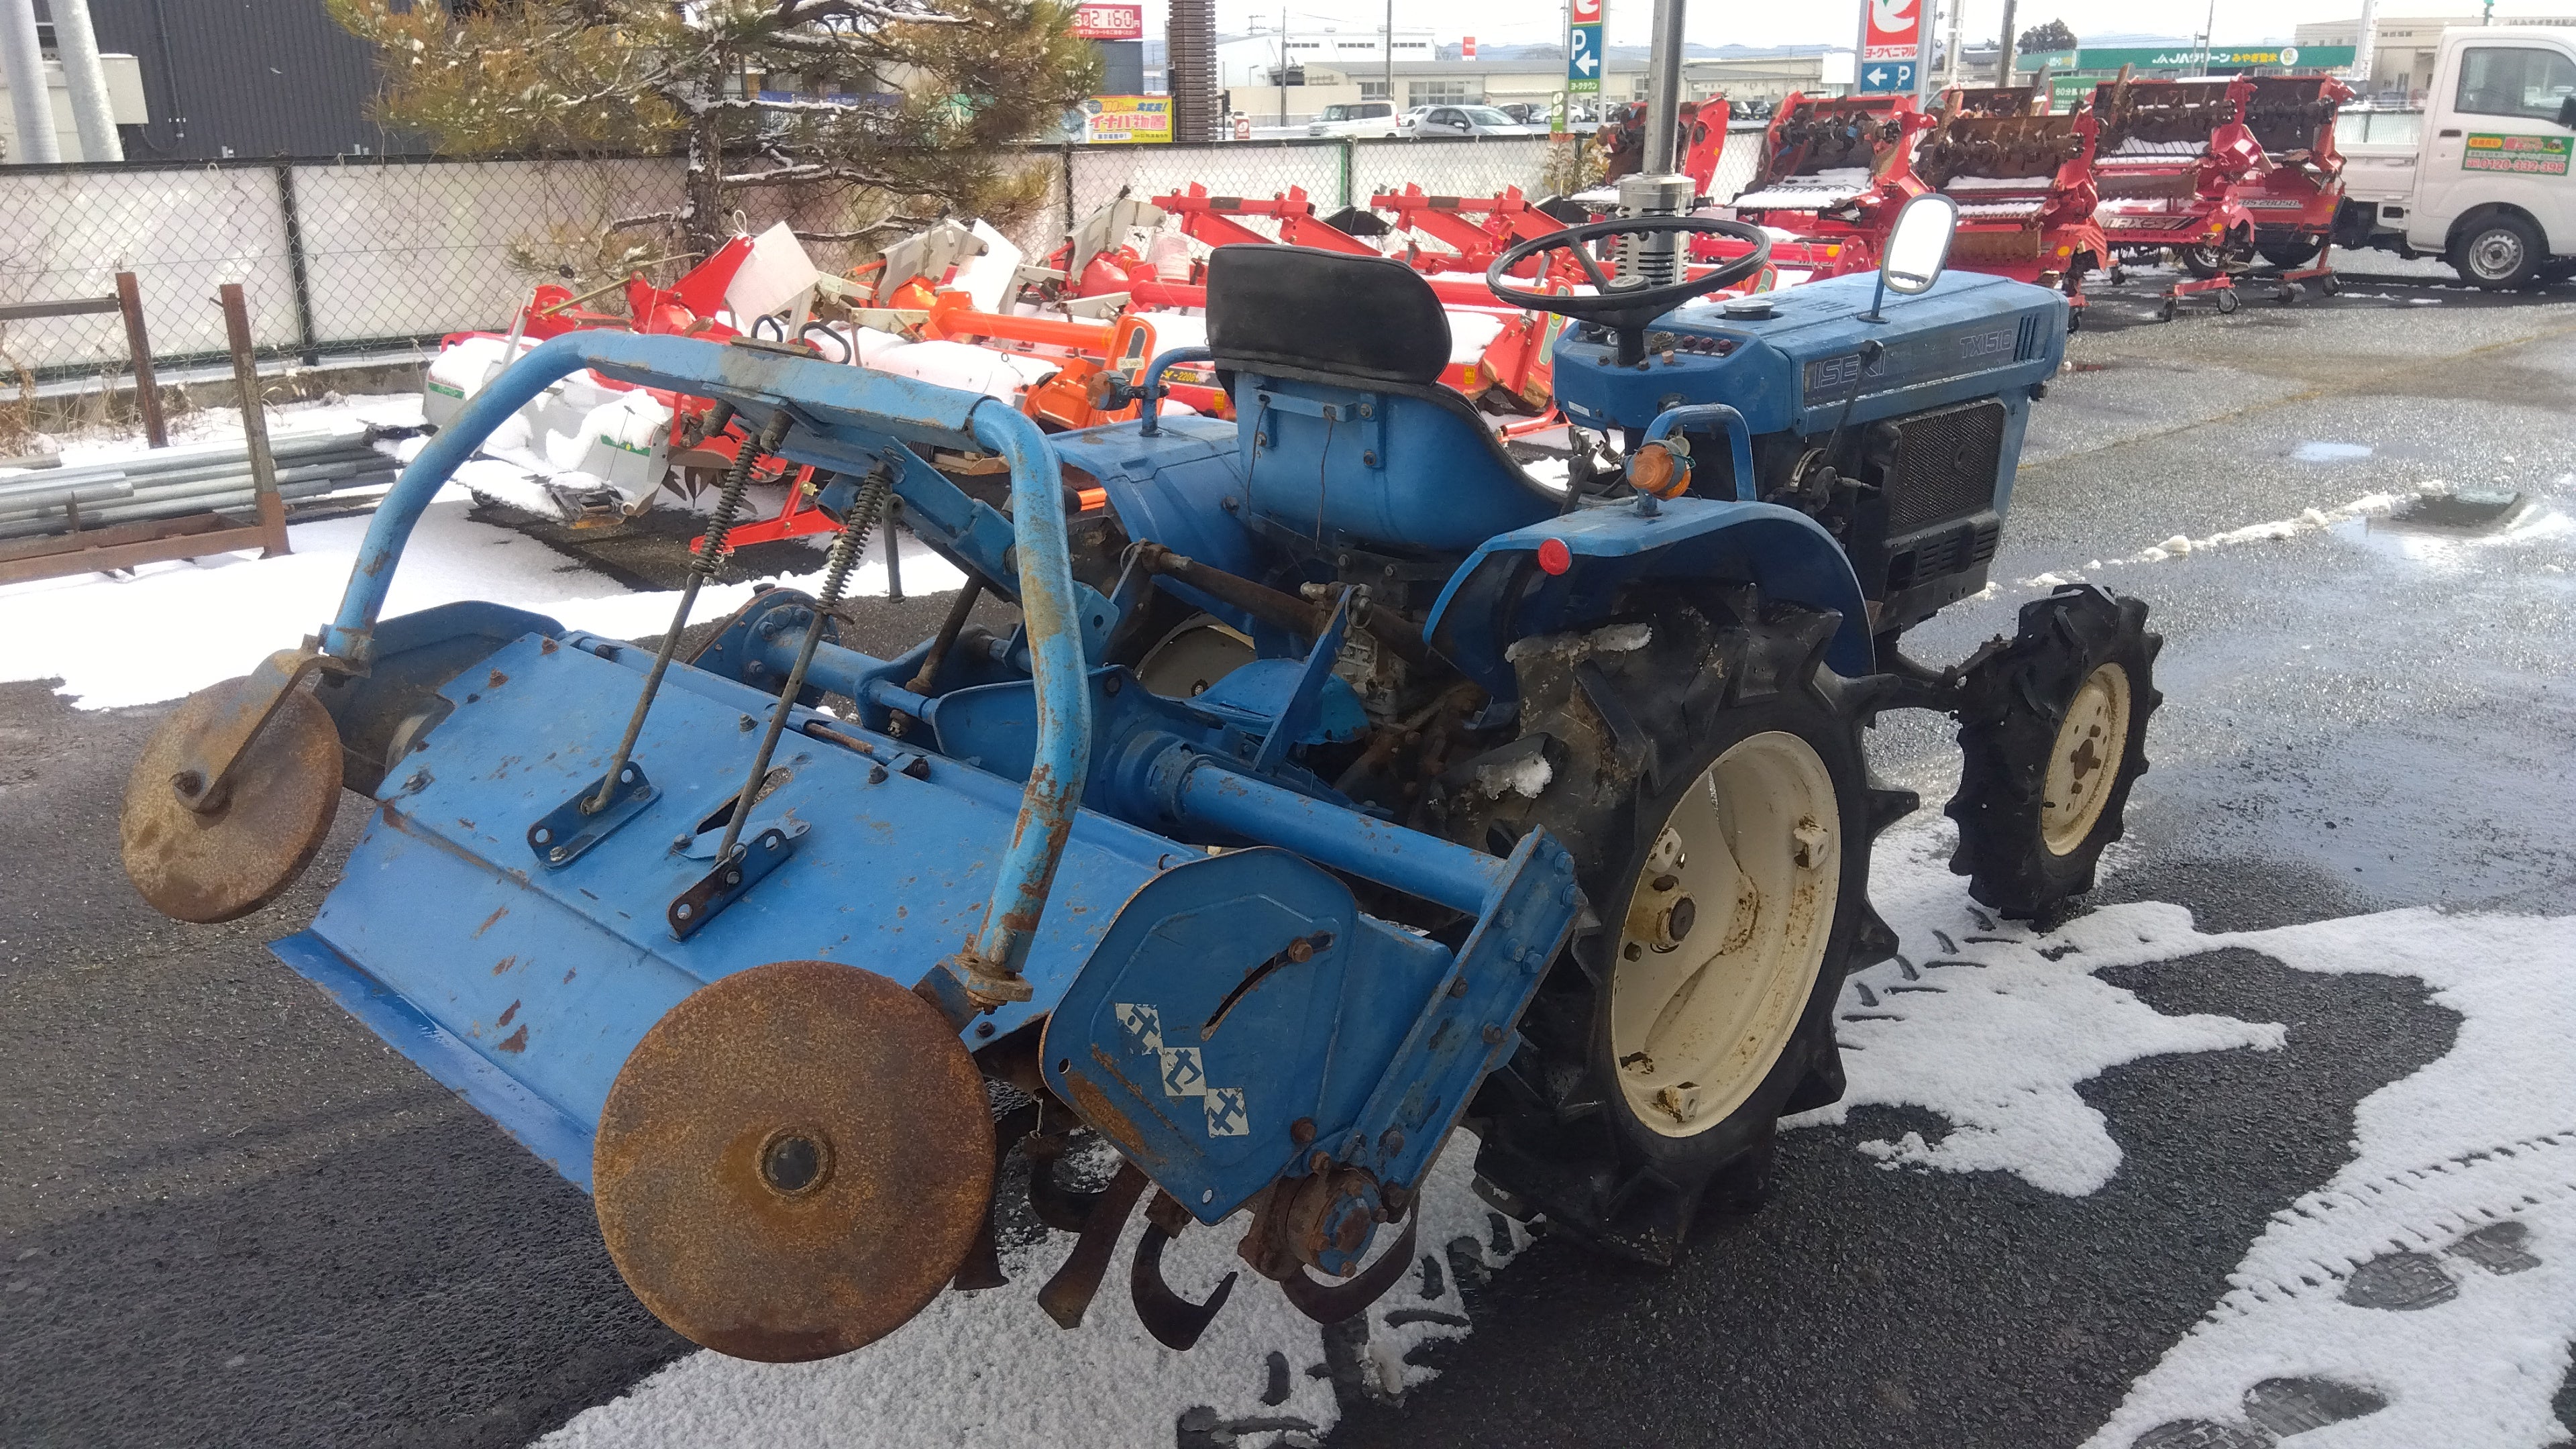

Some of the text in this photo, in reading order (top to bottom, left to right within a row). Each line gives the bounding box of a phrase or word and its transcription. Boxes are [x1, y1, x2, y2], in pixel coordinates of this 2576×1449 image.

[1571, 30, 1587, 60] P
[1864, 46, 1918, 58] ヨークベニマル
[1898, 66, 1910, 86] P
[1570, 82, 1597, 91] ヨークタウン
[1090, 114, 1167, 129] イナバ物置
[2481, 159, 2565, 173] 0120-332-398
[1960, 329, 2013, 358] TX1510
